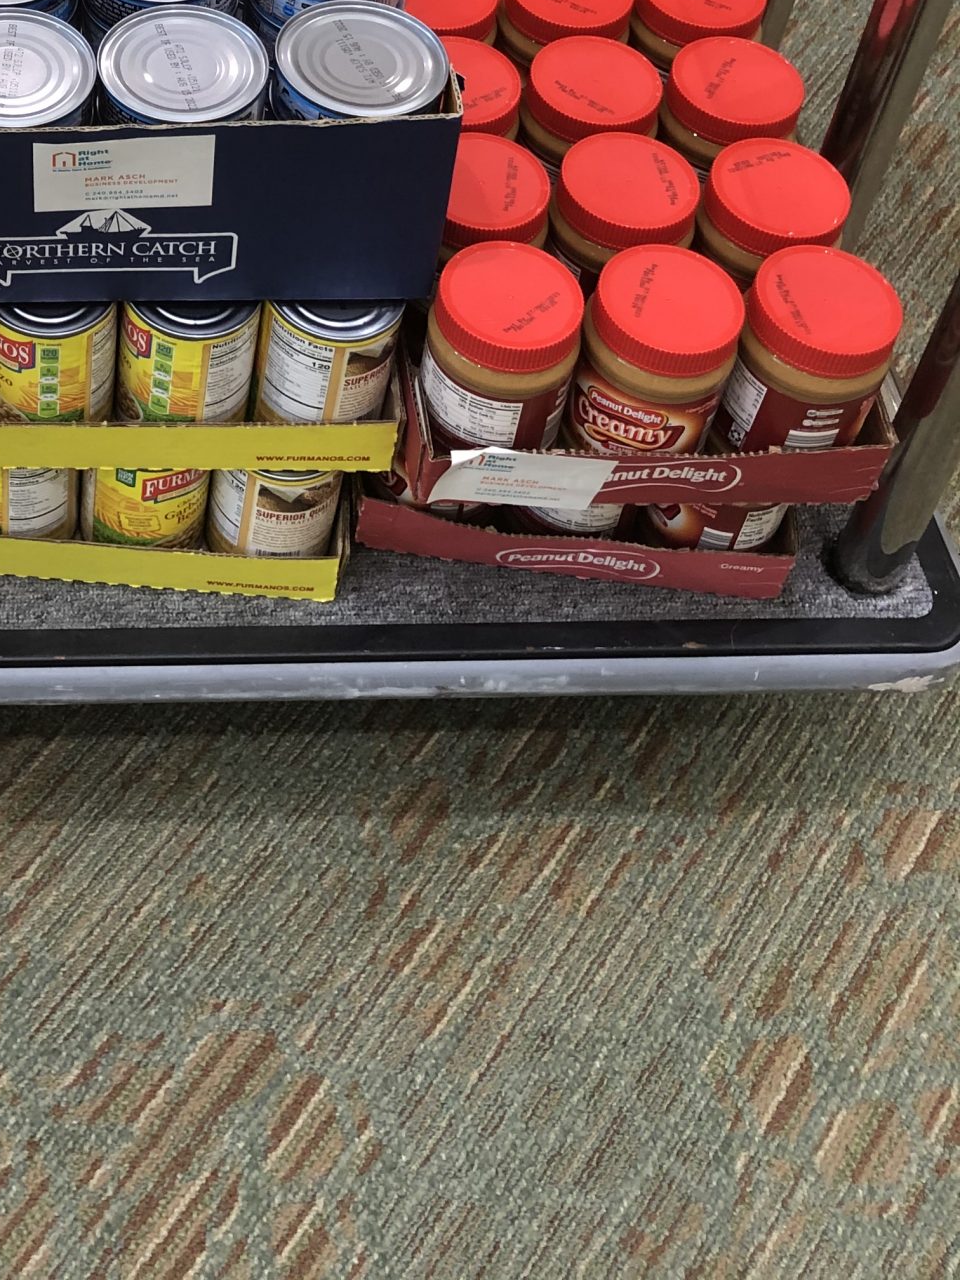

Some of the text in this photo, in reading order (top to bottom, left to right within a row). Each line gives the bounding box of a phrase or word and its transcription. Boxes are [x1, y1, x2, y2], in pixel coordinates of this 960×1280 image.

[78, 149, 109, 157] Right
[85, 175, 114, 183] MARK
[85, 178, 178, 188] BUSINESS DEVELOPMENT
[132, 241, 217, 256] CATCH
[90, 257, 111, 266] OF
[130, 256, 163, 264] THE
[182, 255, 215, 263] SEA
[312, 361, 331, 370] 120
[591, 390, 662, 424] Peanut Delight
[578, 395, 673, 443] Creamy
[652, 466, 728, 483] Delight
[256, 508, 306, 521] SUPERIOR
[507, 551, 648, 573] Peanut Delight
[720, 562, 765, 574] Creamy
[206, 579, 315, 592] WWW.FURMANOS.COM
